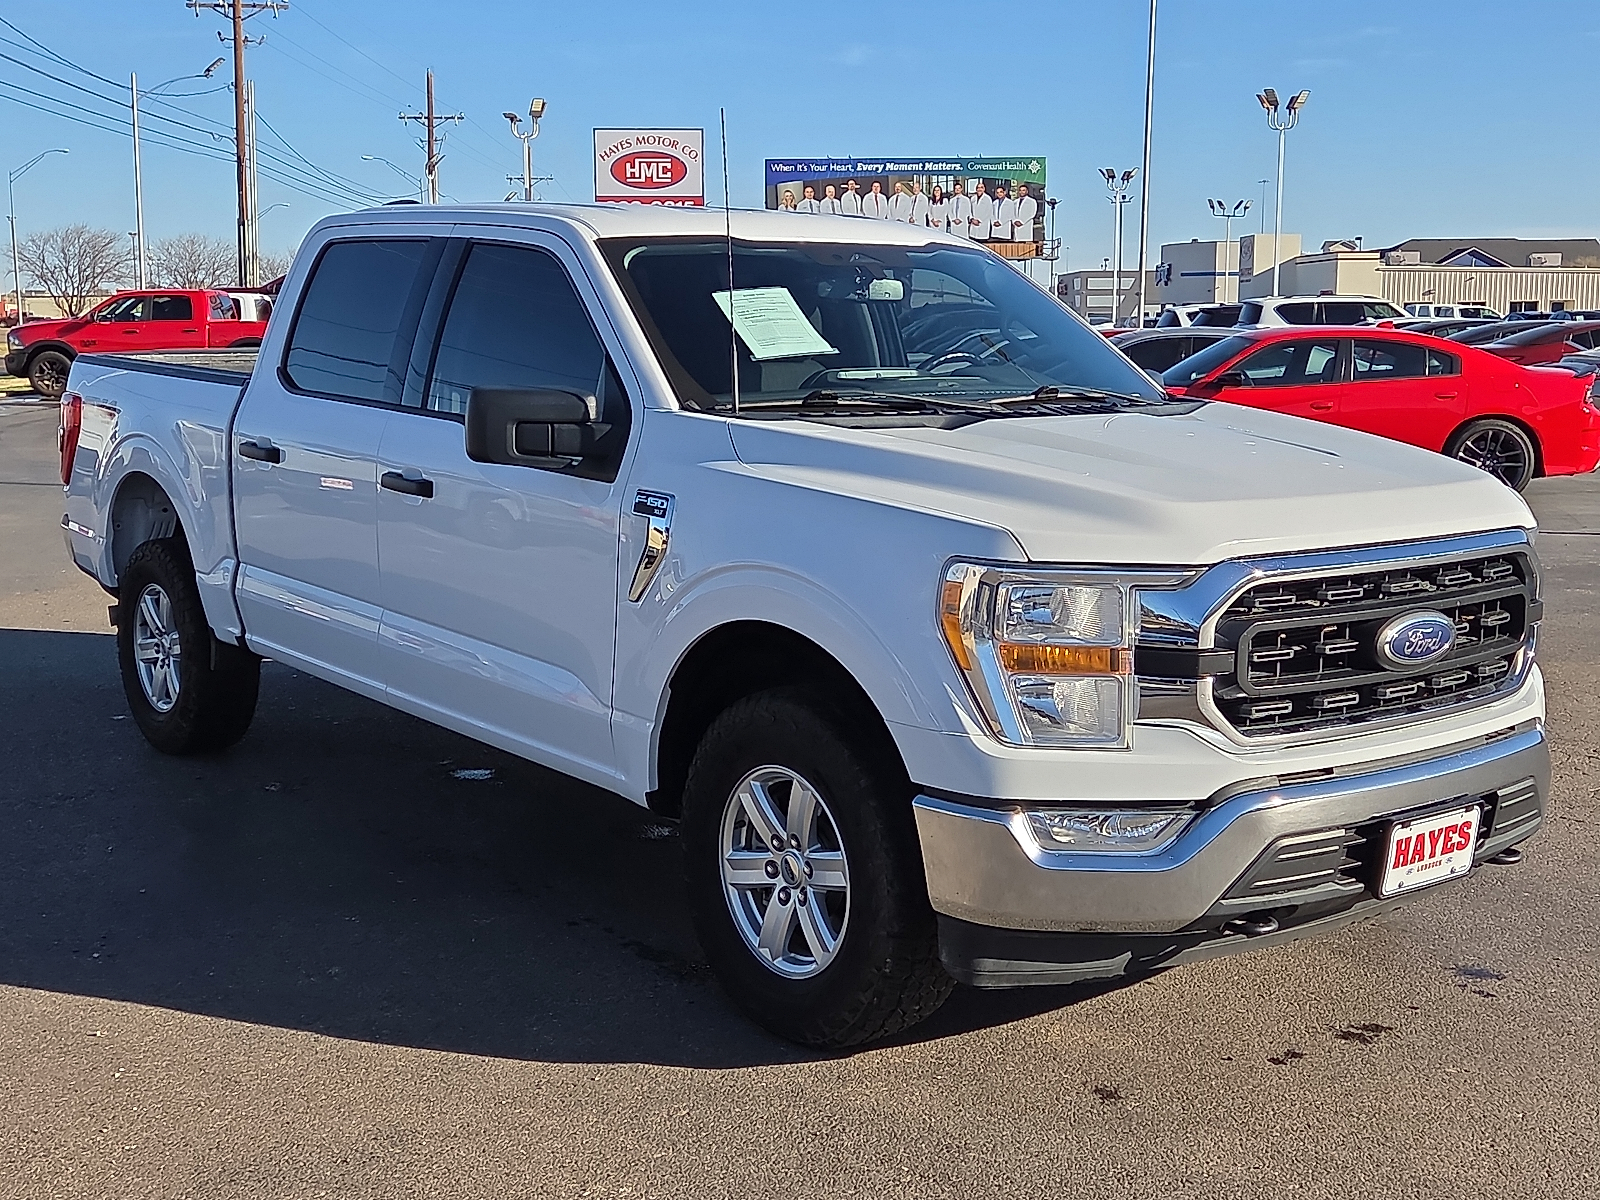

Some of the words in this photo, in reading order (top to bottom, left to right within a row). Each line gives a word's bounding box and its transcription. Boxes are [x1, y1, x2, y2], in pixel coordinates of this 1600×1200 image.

[599, 138, 632, 161] HAYES
[635, 135, 680, 150] MOTOR
[681, 145, 699, 163] CO.
[625, 158, 672, 182] HMC
[770, 163, 795, 172] When
[796, 163, 808, 172] It's
[809, 163, 828, 172] Your
[829, 163, 855, 173] Heart,
[856, 162, 883, 173] Every
[885, 162, 923, 171] Moment
[924, 162, 963, 171] Matters.
[1404, 627, 1443, 655] Ford
[1392, 821, 1472, 870] HAYES
